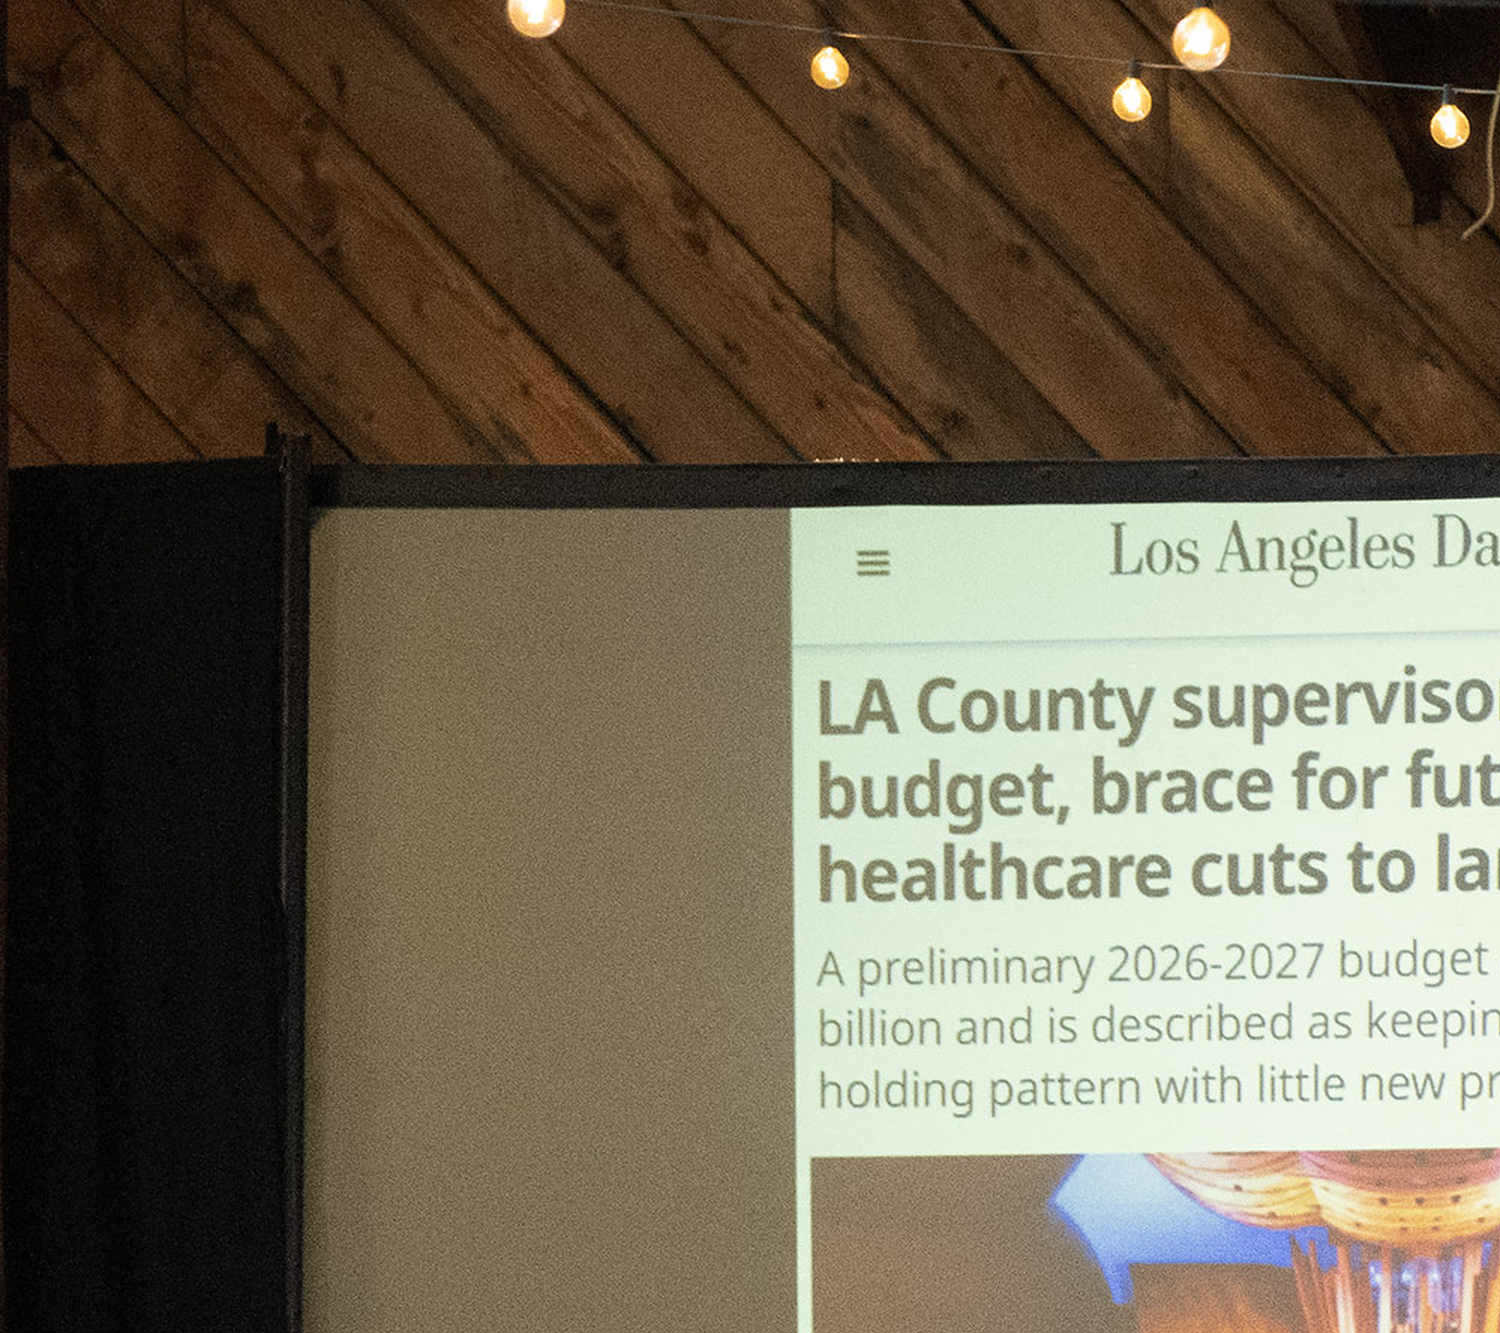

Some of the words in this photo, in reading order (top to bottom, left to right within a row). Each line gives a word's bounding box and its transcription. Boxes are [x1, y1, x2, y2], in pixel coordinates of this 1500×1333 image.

[1110, 522, 1200, 575] Los
[1216, 516, 1415, 589] Angeles
[819, 678, 900, 736] LA
[917, 676, 1156, 748] County
[819, 758, 1070, 835] budget,
[1092, 755, 1274, 815] brace
[1291, 750, 1389, 811] for
[819, 841, 1172, 903] healthcare
[1191, 843, 1328, 897] cuts
[1346, 841, 1416, 894] to
[816, 950, 845, 986] A
[859, 947, 1095, 997] preliminary
[1108, 942, 1324, 982] 2026-2027
[1340, 938, 1488, 988] budget
[819, 1008, 941, 1047] billion
[956, 1006, 1032, 1045] and
[1049, 1016, 1077, 1043] is
[1092, 1002, 1293, 1043] described
[1308, 1011, 1352, 1039] as
[820, 1069, 974, 1119] holding
[990, 1073, 1140, 1118] pattern
[1155, 1065, 1242, 1104] with
[1259, 1064, 1345, 1102] little
[1361, 1073, 1446, 1101] new
